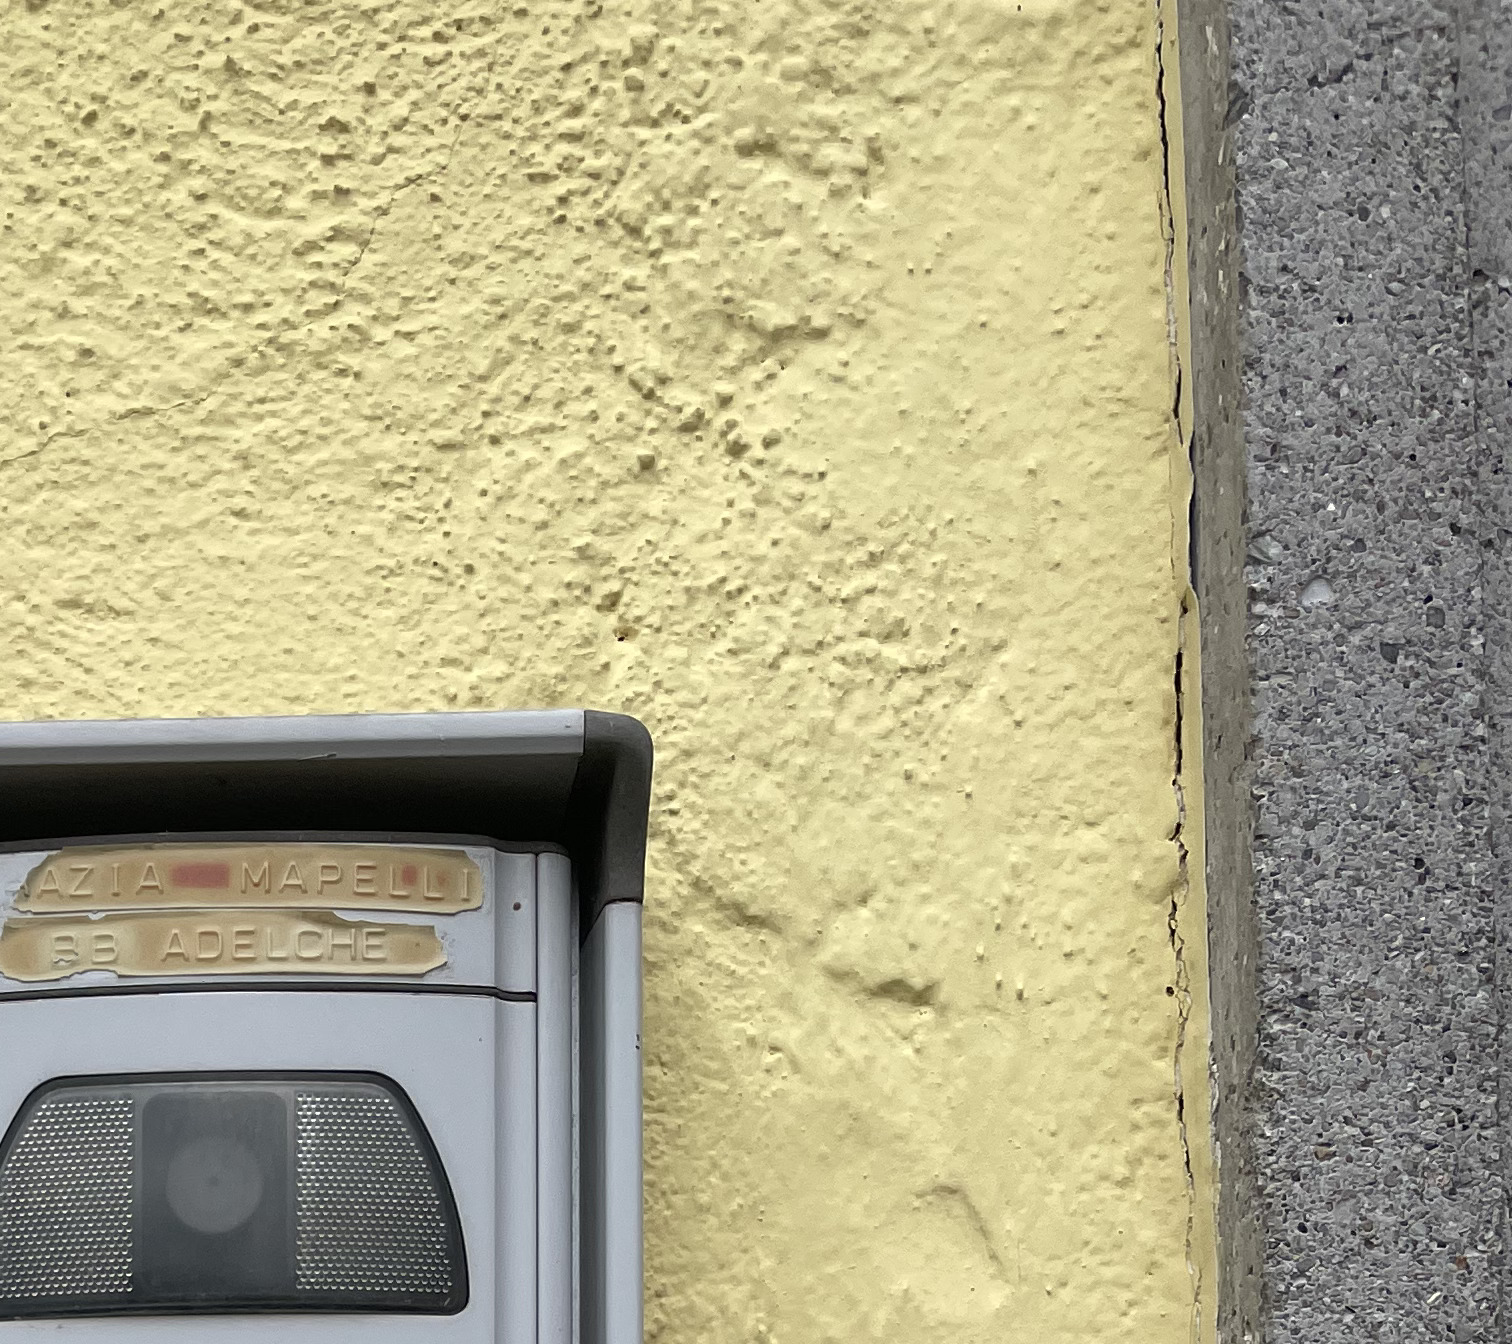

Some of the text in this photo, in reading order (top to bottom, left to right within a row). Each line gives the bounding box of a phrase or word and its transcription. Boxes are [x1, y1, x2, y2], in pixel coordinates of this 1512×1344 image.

[19, 860, 471, 901] AZIA MAPELLI
[161, 925, 388, 963] ADELCHE
